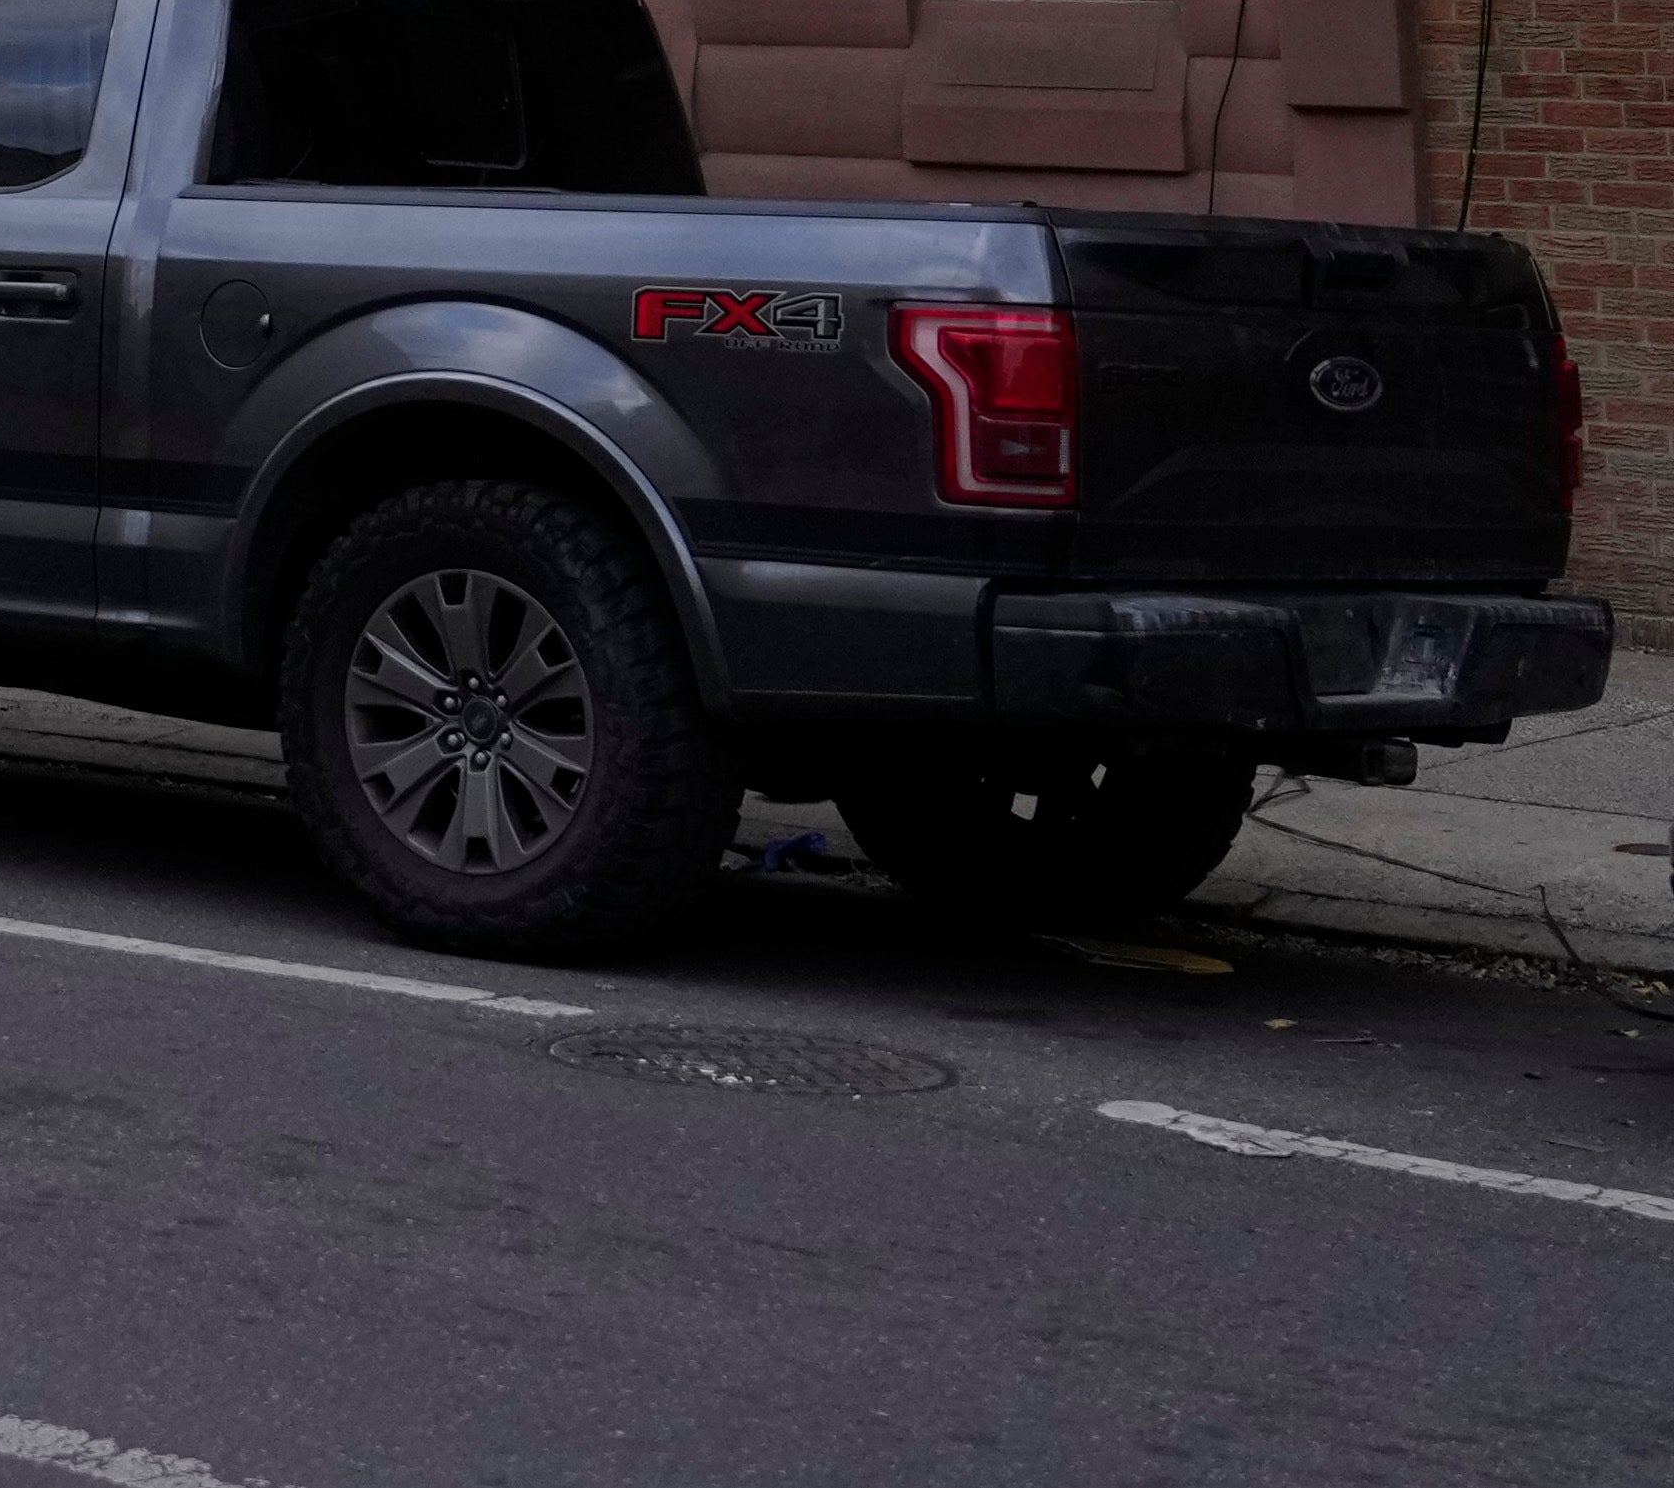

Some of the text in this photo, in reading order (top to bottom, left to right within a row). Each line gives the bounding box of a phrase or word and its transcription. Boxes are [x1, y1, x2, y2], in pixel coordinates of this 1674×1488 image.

[631, 285, 845, 342] FX4
[723, 337, 842, 353] OFF ROAD
